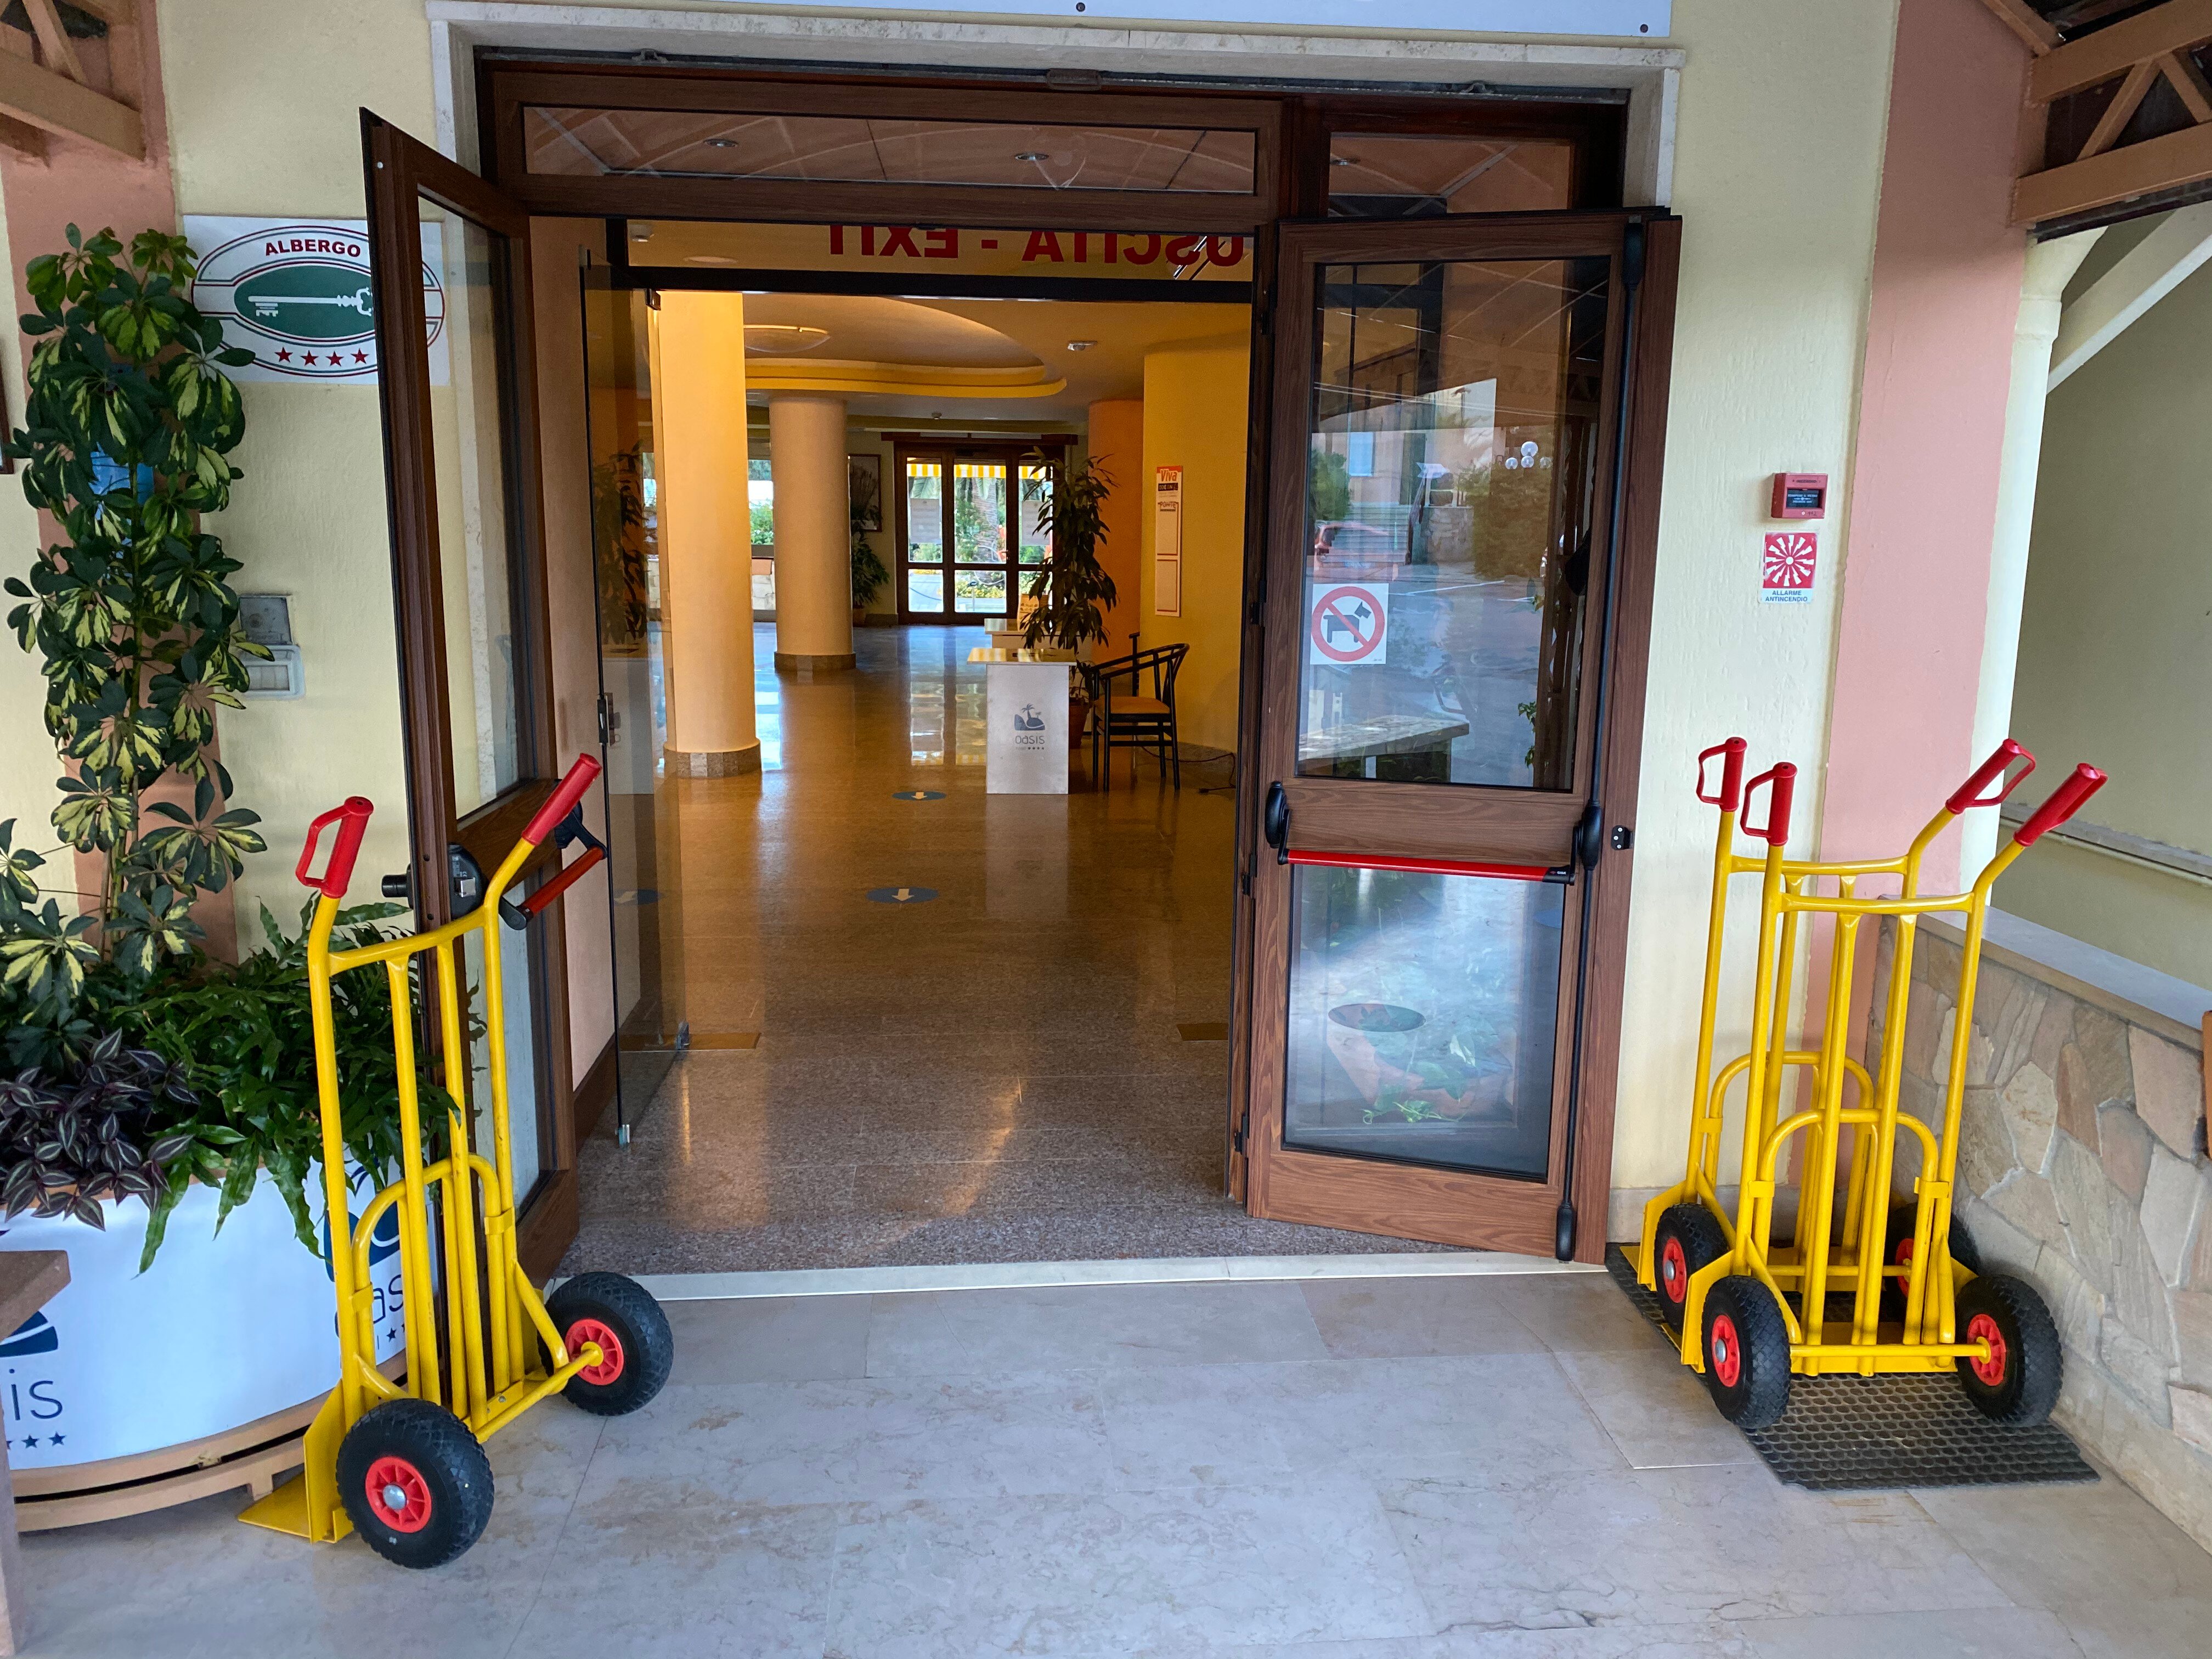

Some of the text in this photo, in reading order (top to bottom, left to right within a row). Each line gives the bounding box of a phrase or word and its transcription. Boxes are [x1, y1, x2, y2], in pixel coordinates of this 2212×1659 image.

[264, 239, 362, 257] ALBERGO
[1160, 470, 1178, 481] Viva
[1015, 735, 1045, 744] oasis
